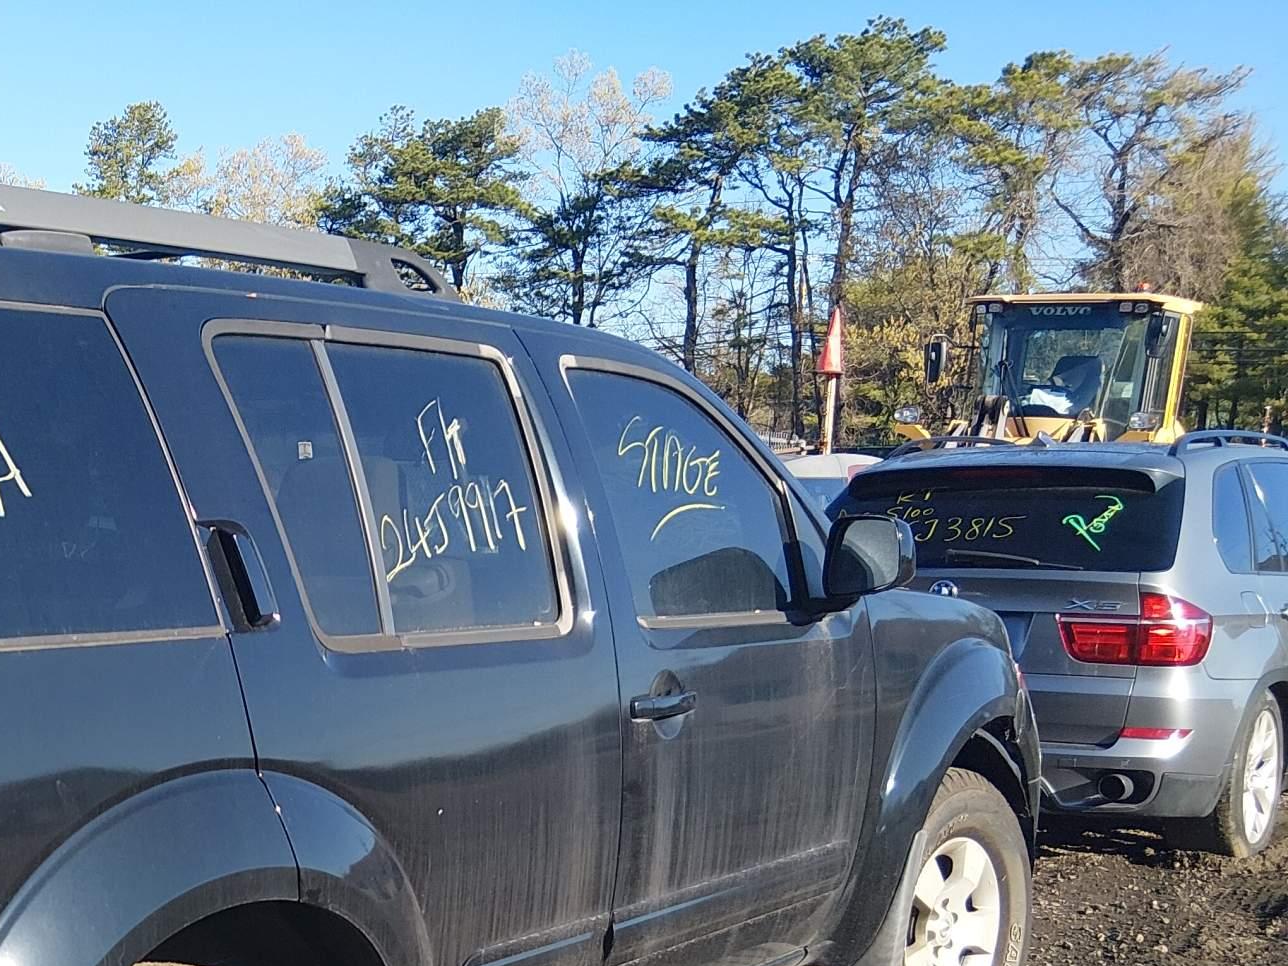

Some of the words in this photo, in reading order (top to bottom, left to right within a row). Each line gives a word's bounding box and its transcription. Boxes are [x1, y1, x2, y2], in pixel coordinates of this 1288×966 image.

[1030, 306, 1091, 316] VOLVO
[618, 416, 721, 496] STAGE
[380, 479, 527, 583] 24J9917
[1064, 599, 1123, 611] X5
